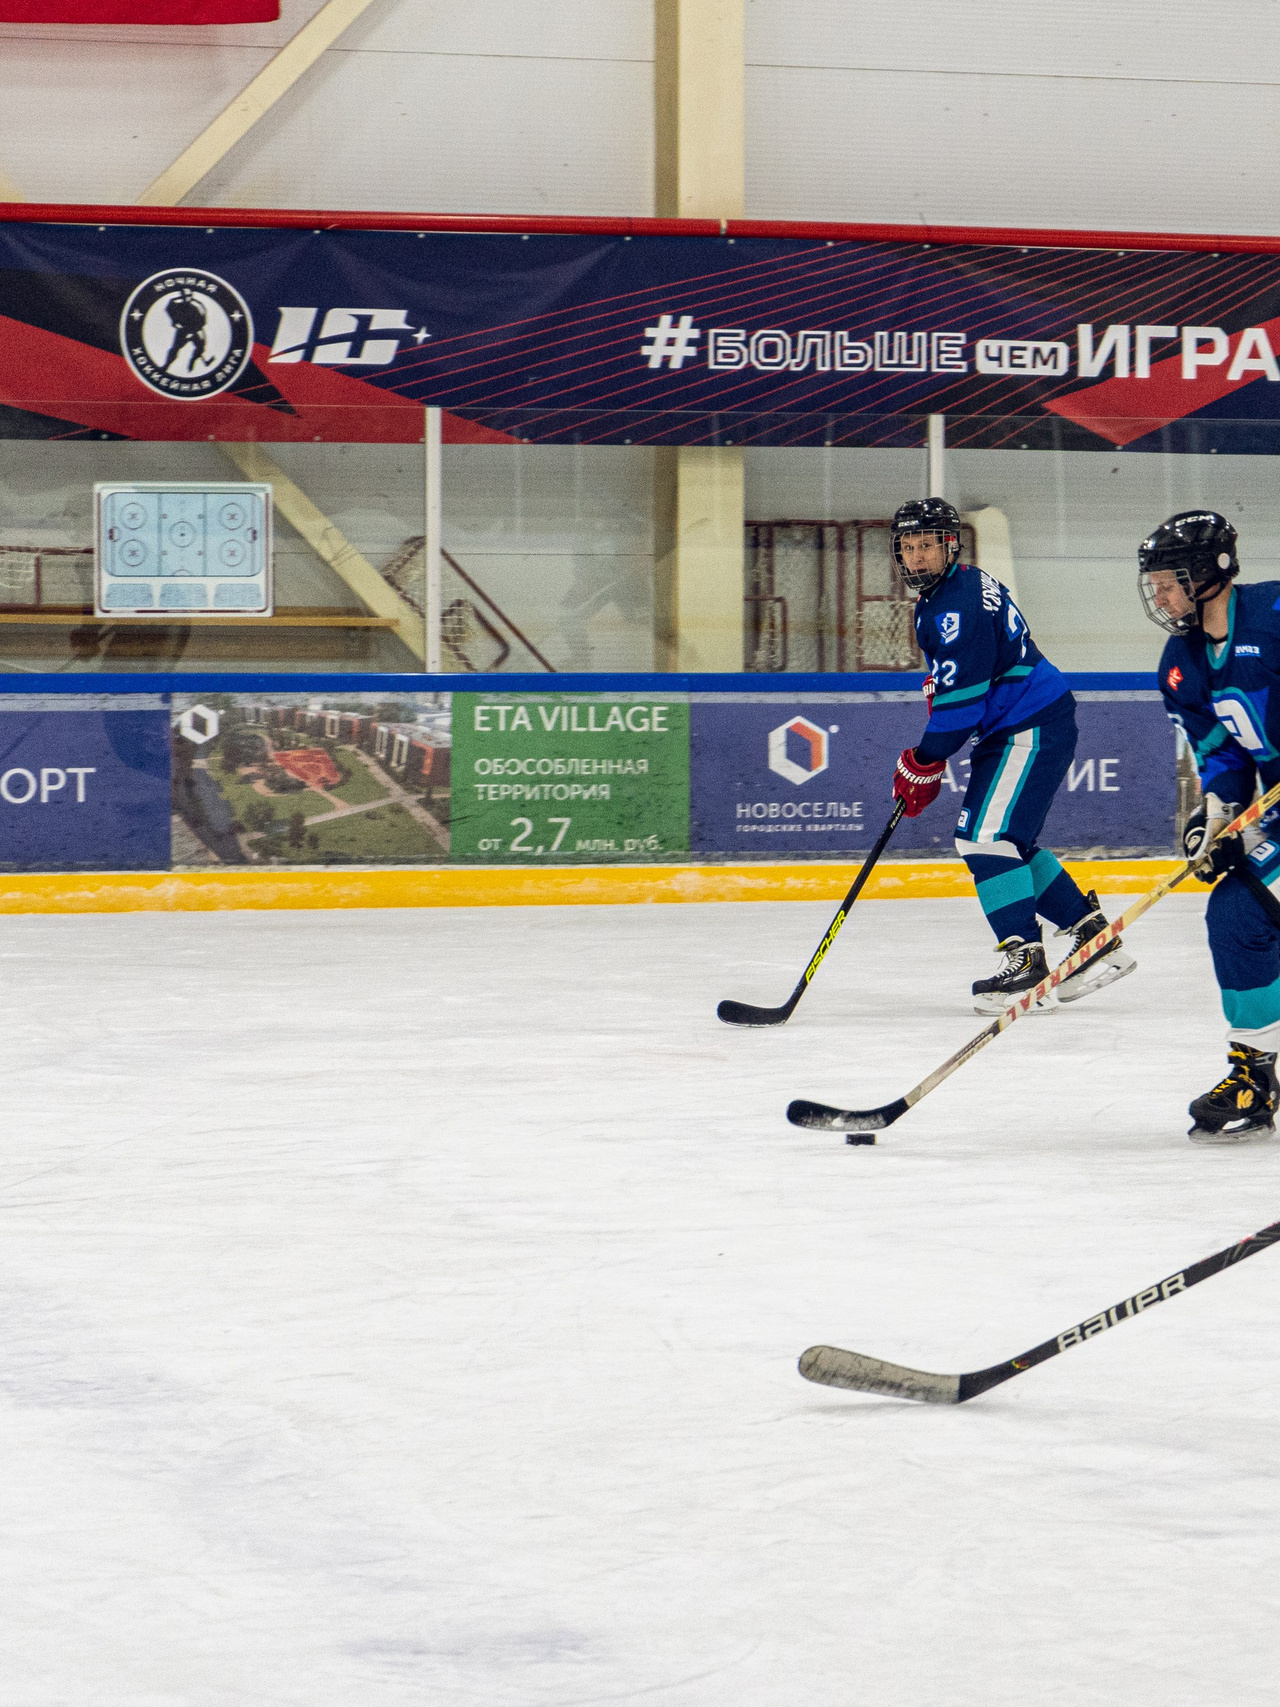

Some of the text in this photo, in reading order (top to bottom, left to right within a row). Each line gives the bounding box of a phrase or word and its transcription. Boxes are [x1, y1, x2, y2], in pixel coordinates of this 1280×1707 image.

[153, 277, 218, 293] НОЧНАЯ
[216, 348, 244, 383] ЛИГА
[979, 343, 1062, 372] ЧЕМ
[1174, 514, 1215, 527] CCM
[474, 705, 669, 732] ETA VILLAGE
[474, 758, 649, 776] ОБОСОБЛЕННАЯ
[474, 784, 611, 801] ТЕРРИТОРИЯ
[736, 801, 864, 819] НОВОСЕЛЬЕ
[509, 817, 572, 855] 2,7
[805, 909, 846, 985] FISCHER
[1006, 917, 1125, 1021] MONTREAL
[1056, 1272, 1189, 1353] BAUER
